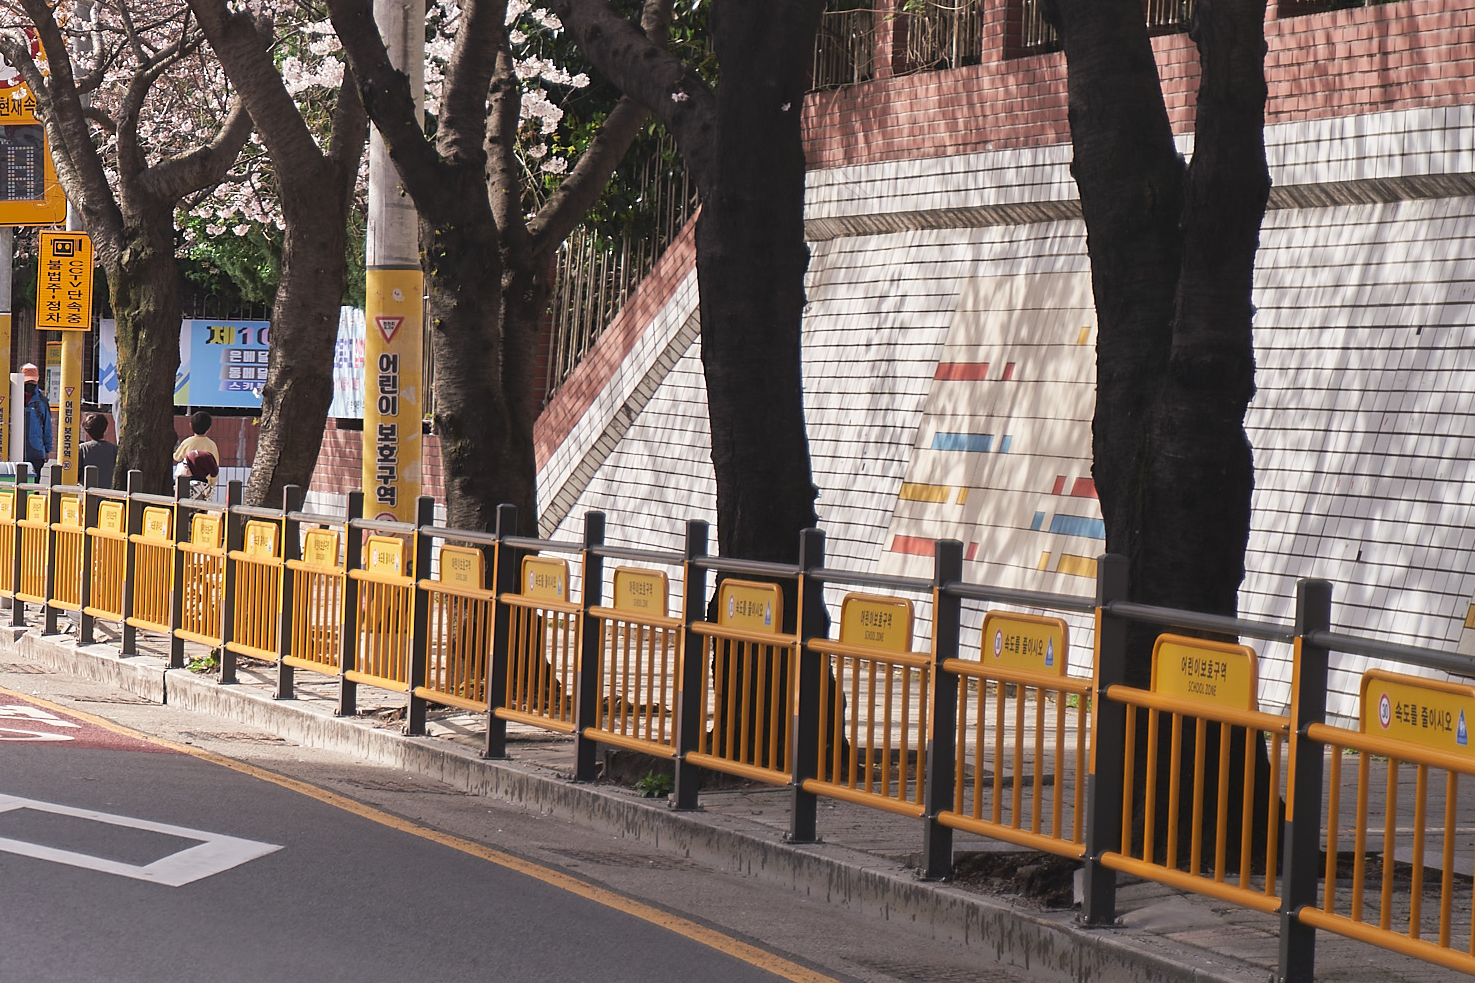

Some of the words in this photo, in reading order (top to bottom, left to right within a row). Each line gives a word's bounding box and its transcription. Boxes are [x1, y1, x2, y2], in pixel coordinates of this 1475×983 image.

[66, 260, 84, 324] CCTV단속중
[378, 353, 400, 417] 어린이
[65, 401, 73, 424] 어린이
[64, 428, 73, 458] 보호구역
[376, 423, 399, 507] 보호구역
[1005, 635, 1020, 654] 속도를
[1022, 637, 1043, 656] 줄이시오
[1181, 656, 1227, 682] 어린이보호구역
[1188, 680, 1204, 694] SCHOOL
[1205, 683, 1216, 696] ZONE
[1395, 701, 1418, 726] 속도를
[1421, 707, 1452, 732] 줄이시오
